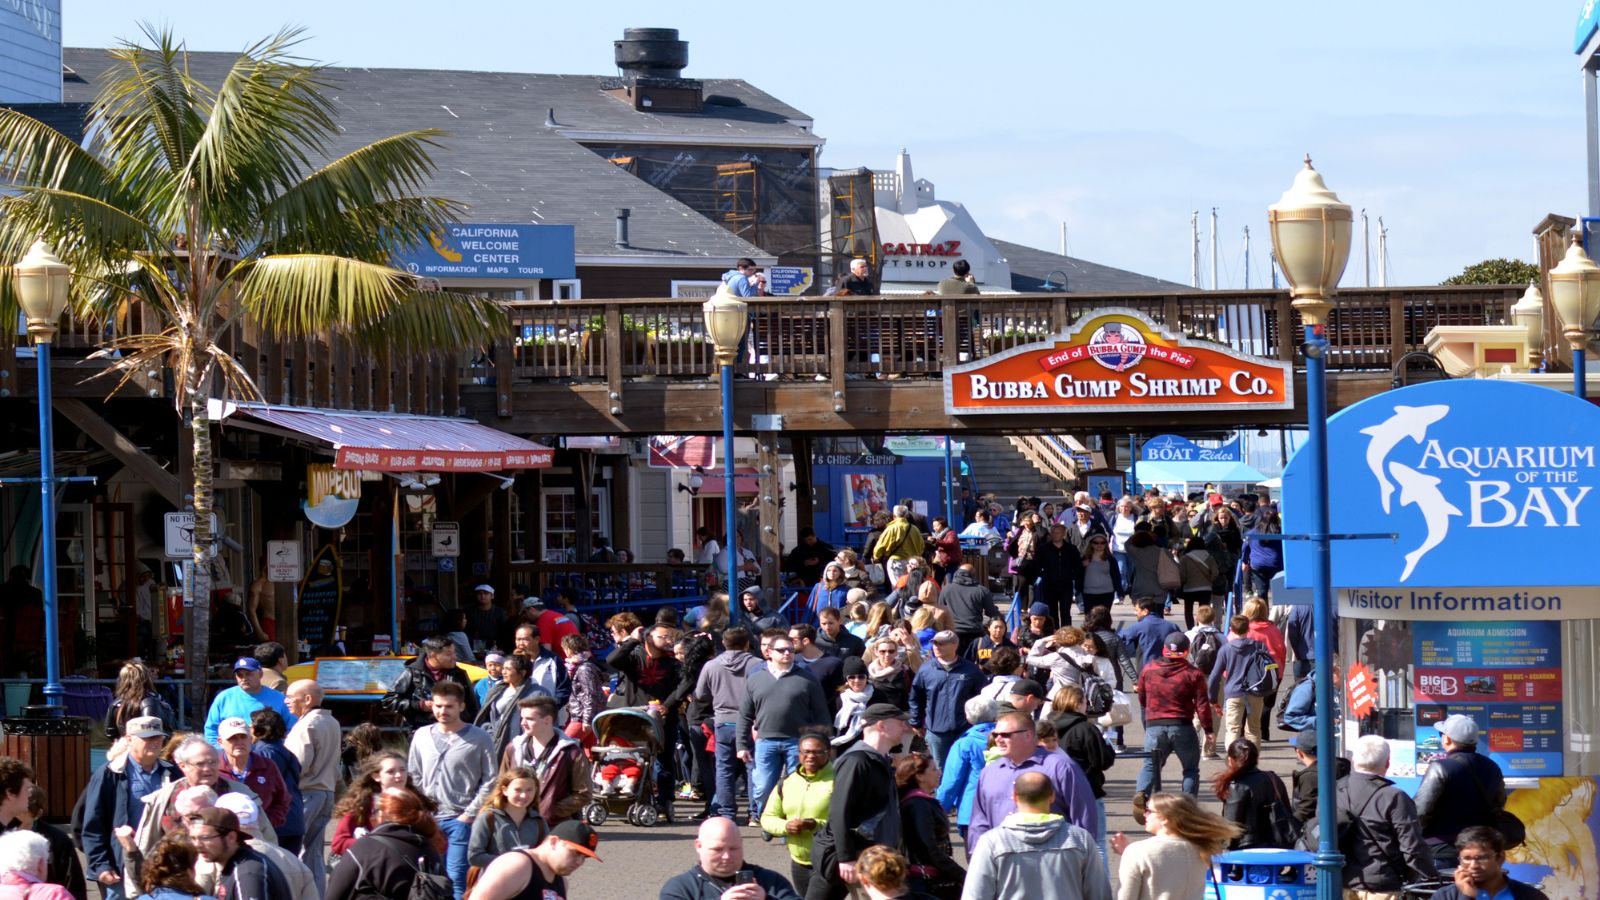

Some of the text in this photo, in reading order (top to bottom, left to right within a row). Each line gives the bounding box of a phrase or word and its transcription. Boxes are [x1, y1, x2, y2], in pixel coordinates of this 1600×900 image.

[452, 228, 519, 238] CALIFORNIA
[461, 241, 519, 250] WELCOME
[473, 254, 519, 263] CENTER
[905, 260, 947, 268] SHOP
[425, 265, 477, 273] INFORMATION
[487, 266, 509, 274] MAPS
[1089, 344, 1146, 354] BUBBA GUMP
[1048, 348, 1083, 366] End of
[1150, 347, 1192, 366] the Pier
[970, 370, 1274, 400] BUBBA GUMP SHRIMP CO.
[1148, 448, 1234, 461] BOAT Rides
[1417, 439, 1595, 477] AQUARIUM
[865, 455, 896, 465] SHRIMP
[1515, 471, 1578, 483] OF THE
[312, 470, 362, 507] WIPEOUT
[1466, 480, 1593, 528] BAY
[170, 515, 180, 523] NO
[1347, 589, 1562, 611] Visitor Information
[1447, 628, 1527, 637] AQUARIUM ADMISSION
[1420, 675, 1441, 686] BIG
[1420, 685, 1441, 695] BUS
